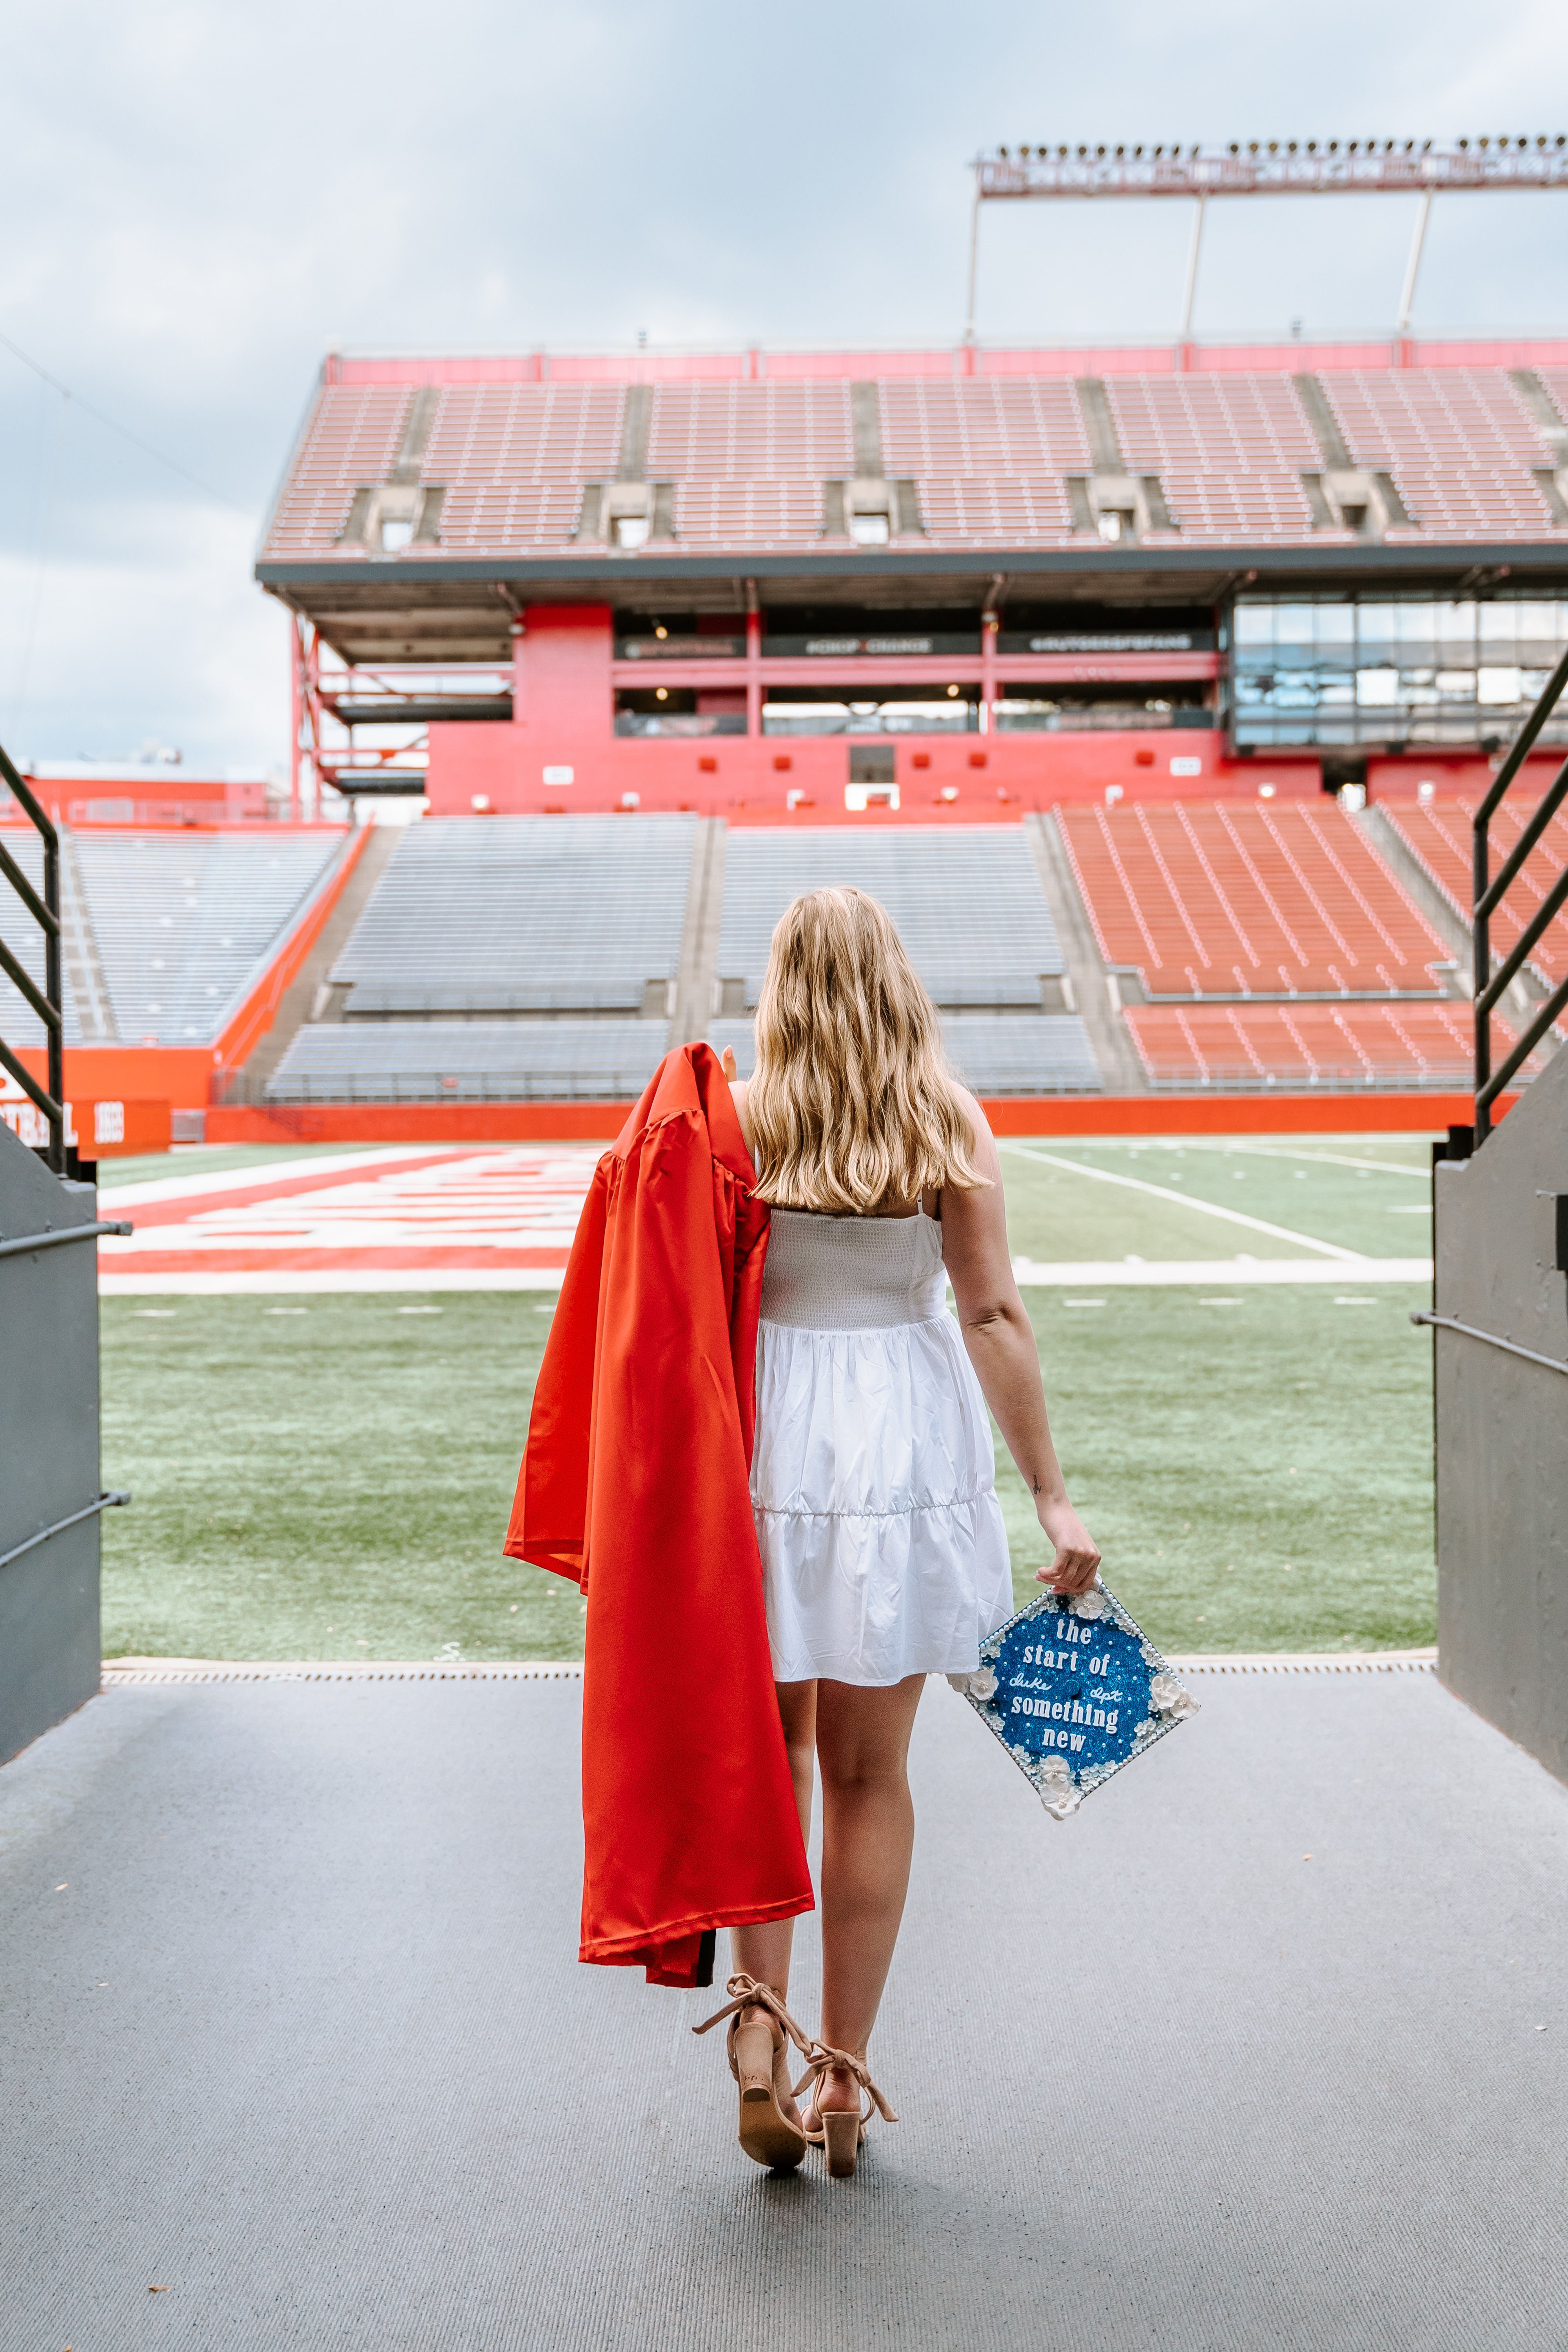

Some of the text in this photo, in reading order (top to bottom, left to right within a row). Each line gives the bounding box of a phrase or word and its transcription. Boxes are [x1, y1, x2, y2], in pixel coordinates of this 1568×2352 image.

[1057, 1619, 1091, 1644] the
[1023, 1645, 1110, 1676] start of
[1009, 1672, 1052, 1690] duke
[1011, 1697, 1118, 1734] something
[1042, 1729, 1086, 1752] new
